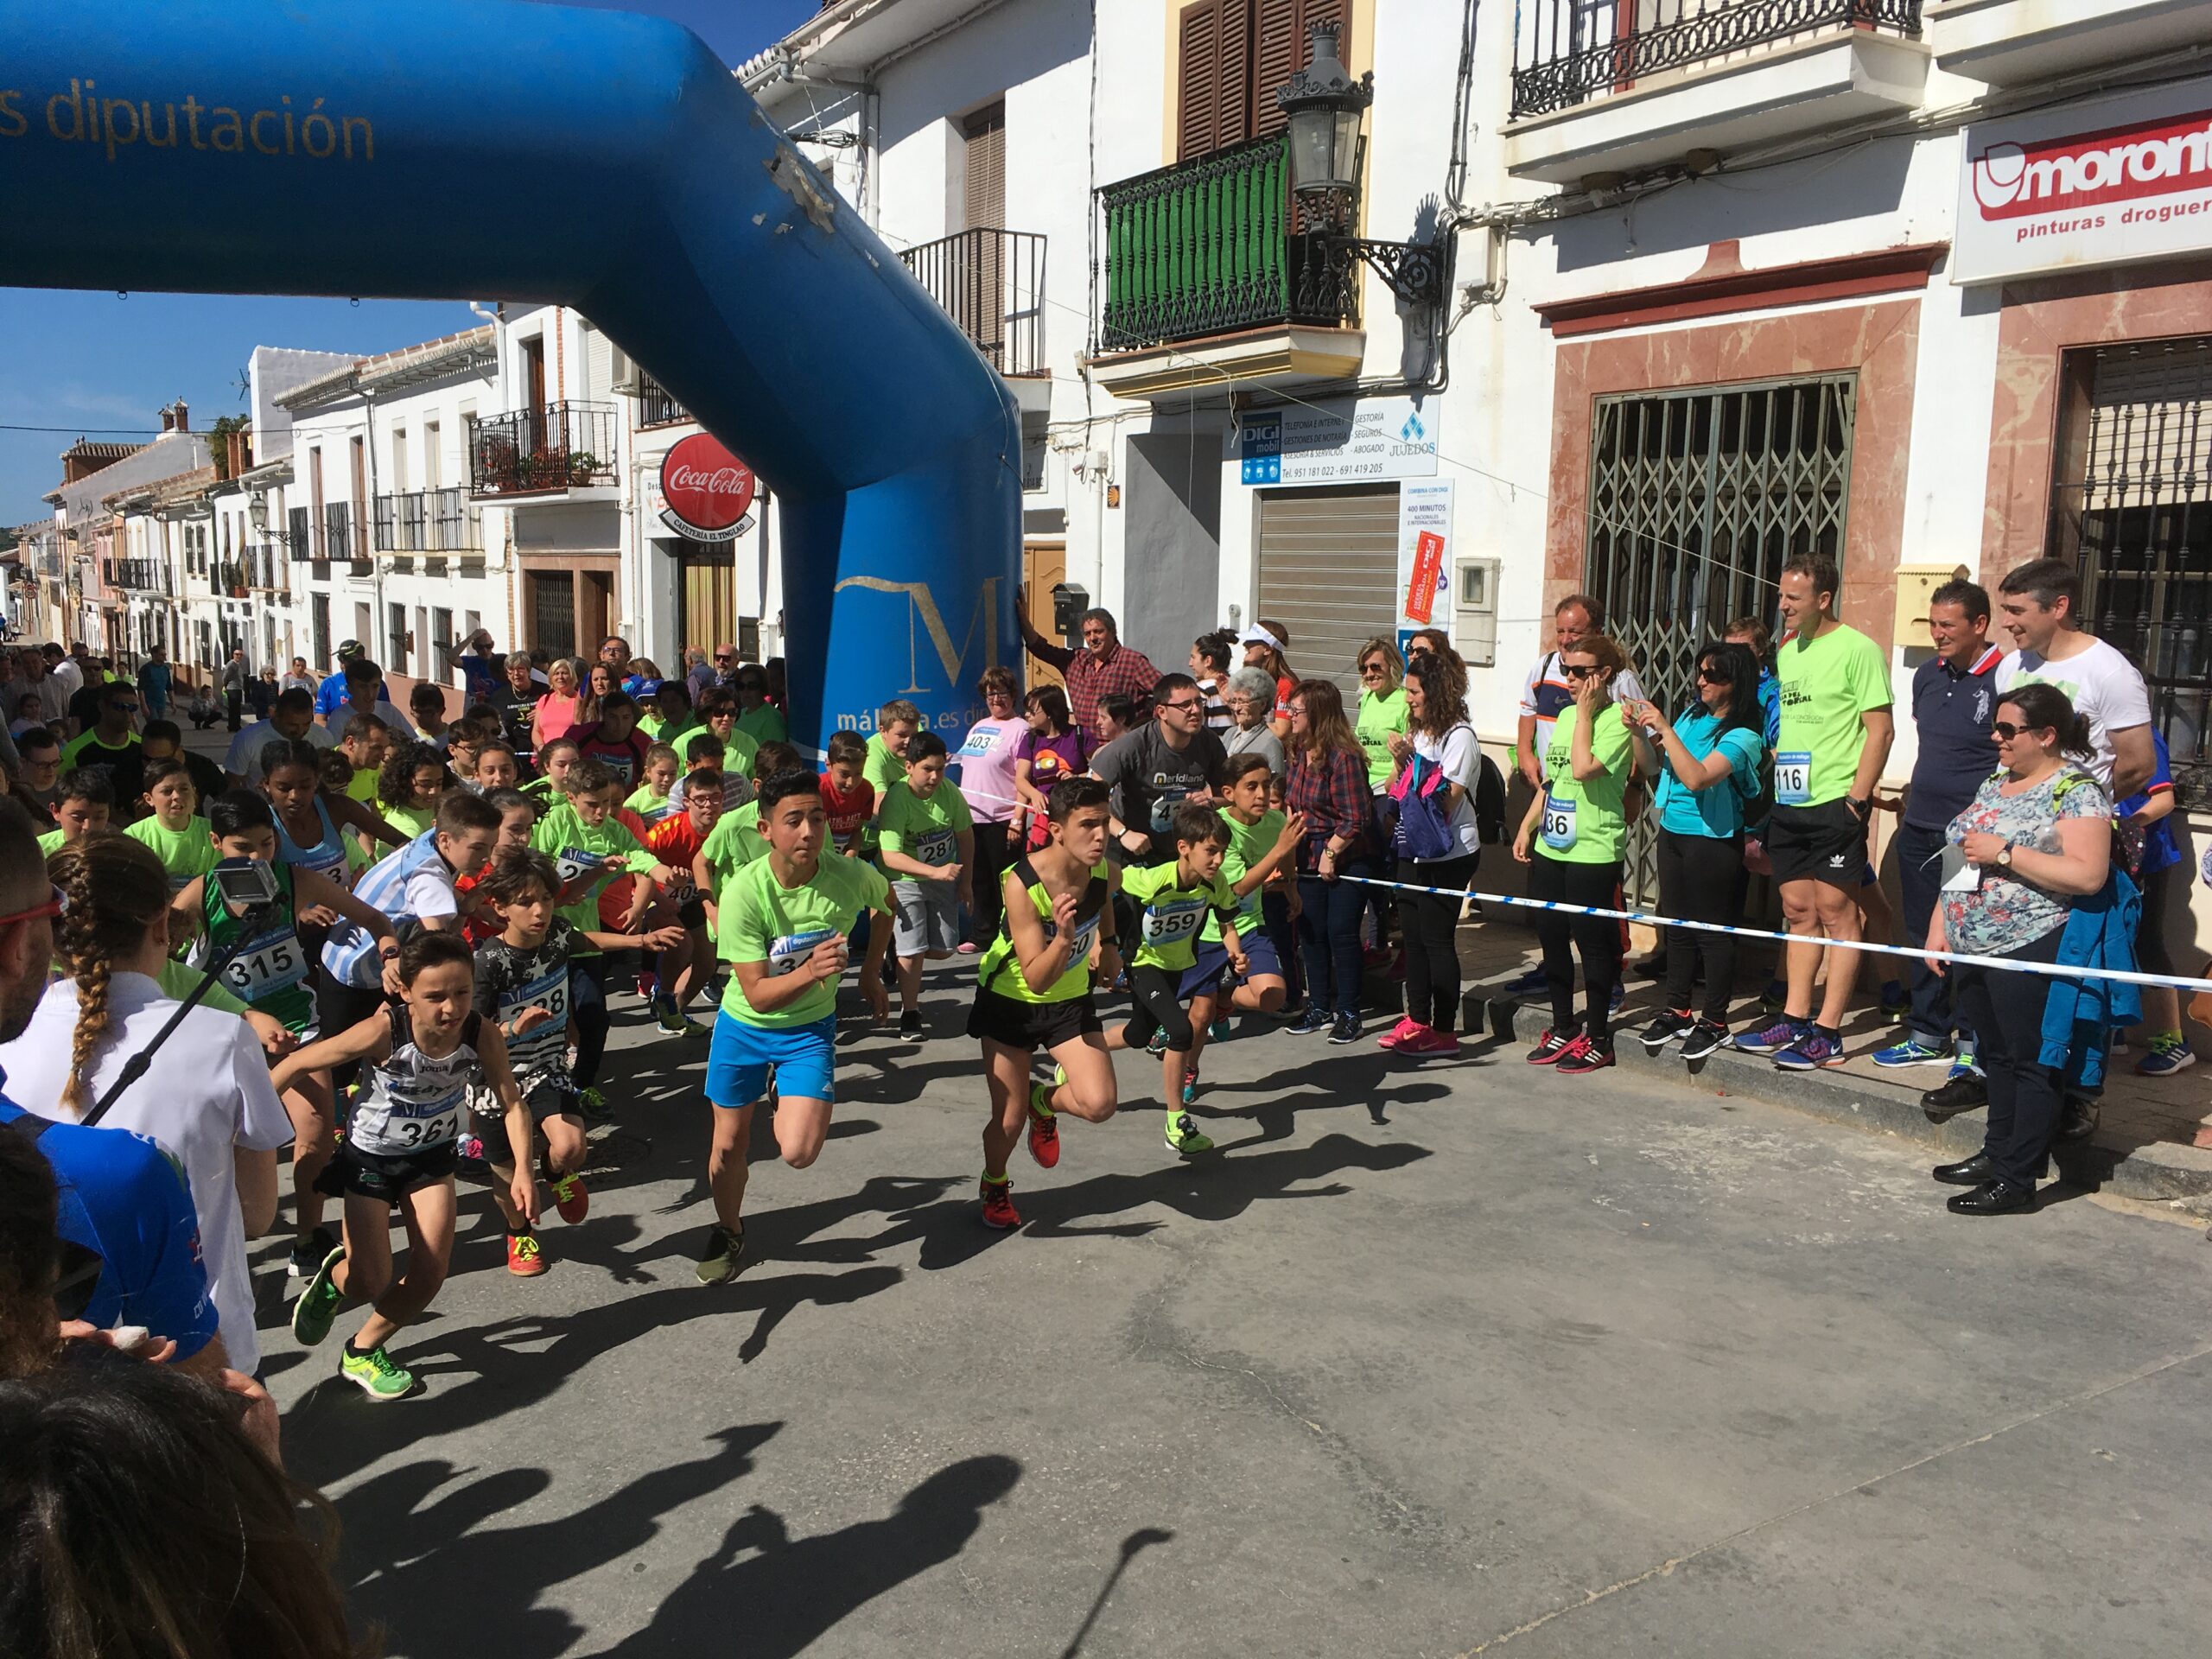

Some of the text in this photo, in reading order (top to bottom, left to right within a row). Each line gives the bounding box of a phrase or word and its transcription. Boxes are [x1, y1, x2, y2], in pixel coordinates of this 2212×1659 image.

[46, 78, 374, 162] diputación
[2016, 215, 2106, 243] pinturas
[1354, 411, 1384, 423] GESTORÍA
[1243, 425, 1280, 442] DIGI
[1283, 435, 1313, 446] GESTIONES
[1313, 434, 1321, 443] DE
[1354, 429, 1382, 438] SEGUROS
[1256, 439, 1280, 453] mobil
[1353, 443, 1384, 454] ABOGADO
[1389, 442, 1435, 457] JUJEDOS
[670, 464, 750, 495] Coca-Cola
[1282, 468, 1293, 478] Tel.
[1294, 467, 1306, 477] 951
[1308, 467, 1319, 477] 181
[1320, 466, 1334, 476] 022
[1339, 465, 1352, 475] 691
[1354, 464, 1368, 474] 419
[1369, 463, 1382, 474] 205
[674, 518, 708, 539] CAFETERÍA
[709, 531, 718, 540] EL
[718, 524, 745, 539] TINGLAO
[967, 735, 991, 749] 403
[1776, 768, 1802, 791] 116
[924, 835, 955, 864] 287
[1148, 912, 1197, 938] 359
[228, 945, 293, 988] 315
[398, 1112, 459, 1147] 361
